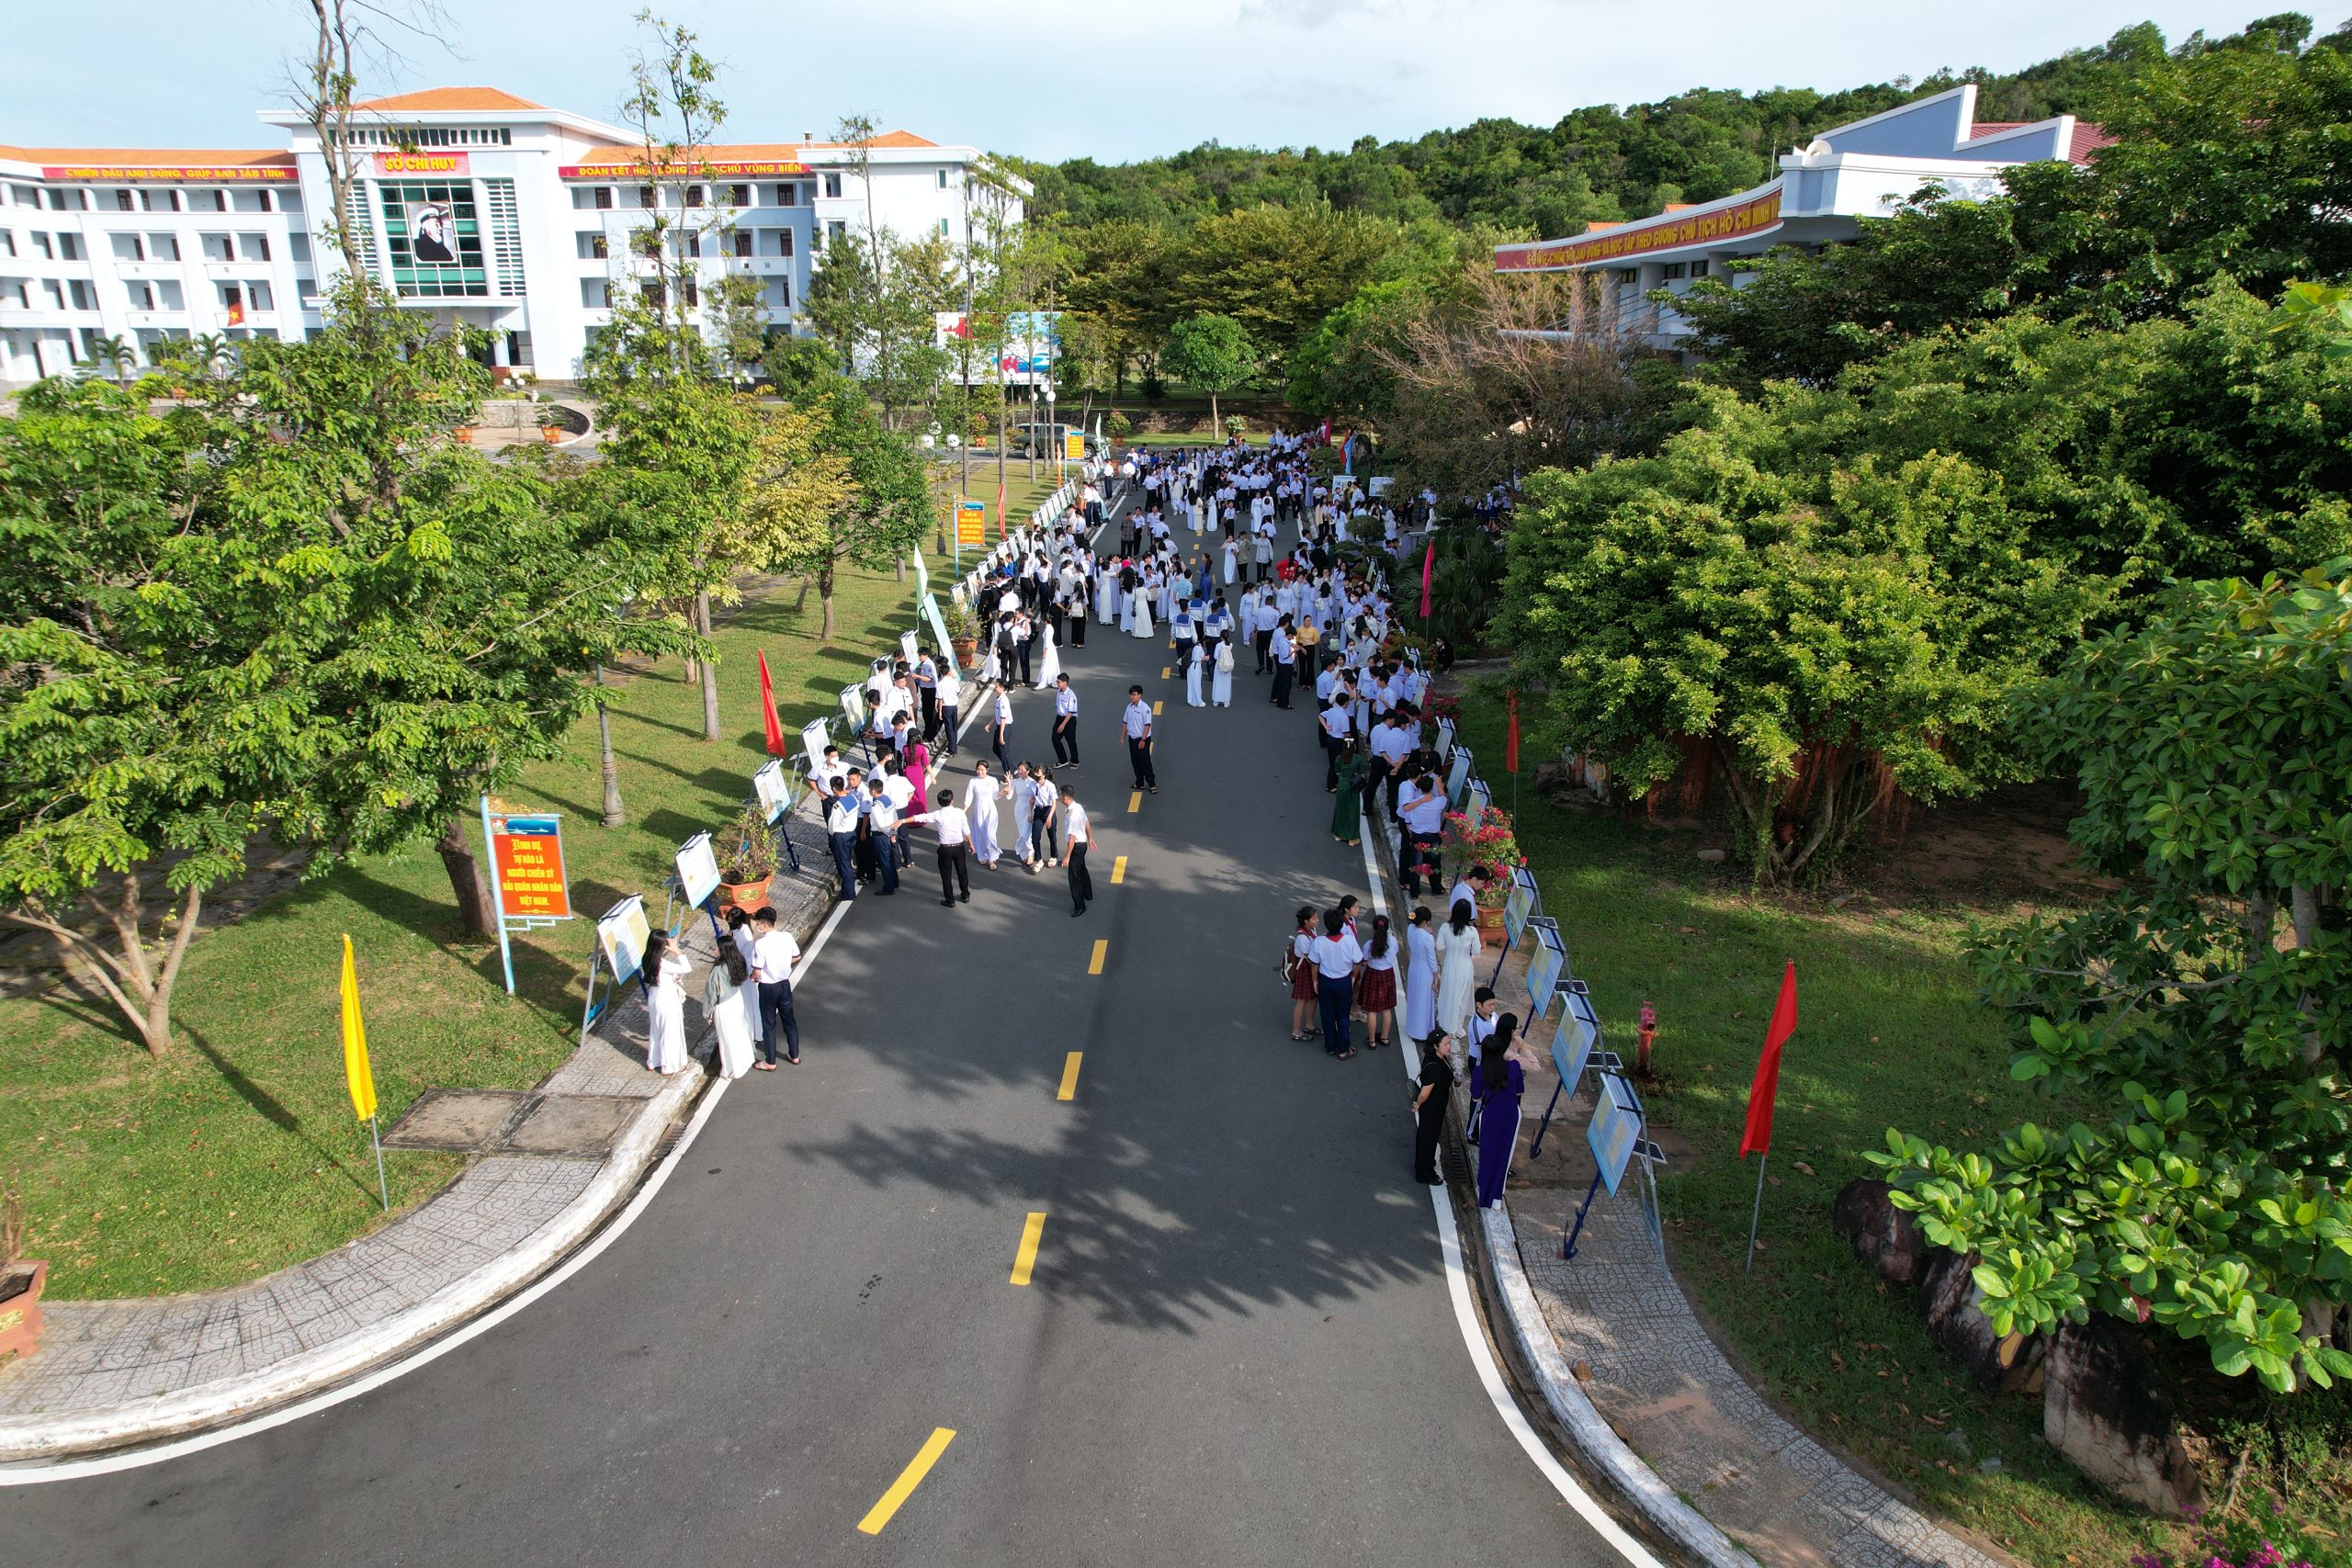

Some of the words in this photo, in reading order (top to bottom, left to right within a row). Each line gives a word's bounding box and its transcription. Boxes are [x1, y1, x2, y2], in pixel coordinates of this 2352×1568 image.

[385, 153, 403, 171] SỞ
[430, 157, 456, 170] HUY
[744, 162, 775, 173] VÙNG
[1636, 231, 1652, 249] THEO
[1699, 218, 1716, 243] TỊCH
[1719, 209, 1734, 234] HỒ
[1736, 203, 1752, 231] CHÍ
[1752, 201, 1770, 227] MINH
[513, 854, 522, 865] TỰ
[523, 854, 536, 864] HÀO
[536, 854, 544, 864] LÀ
[519, 895, 533, 907] VIỆT
